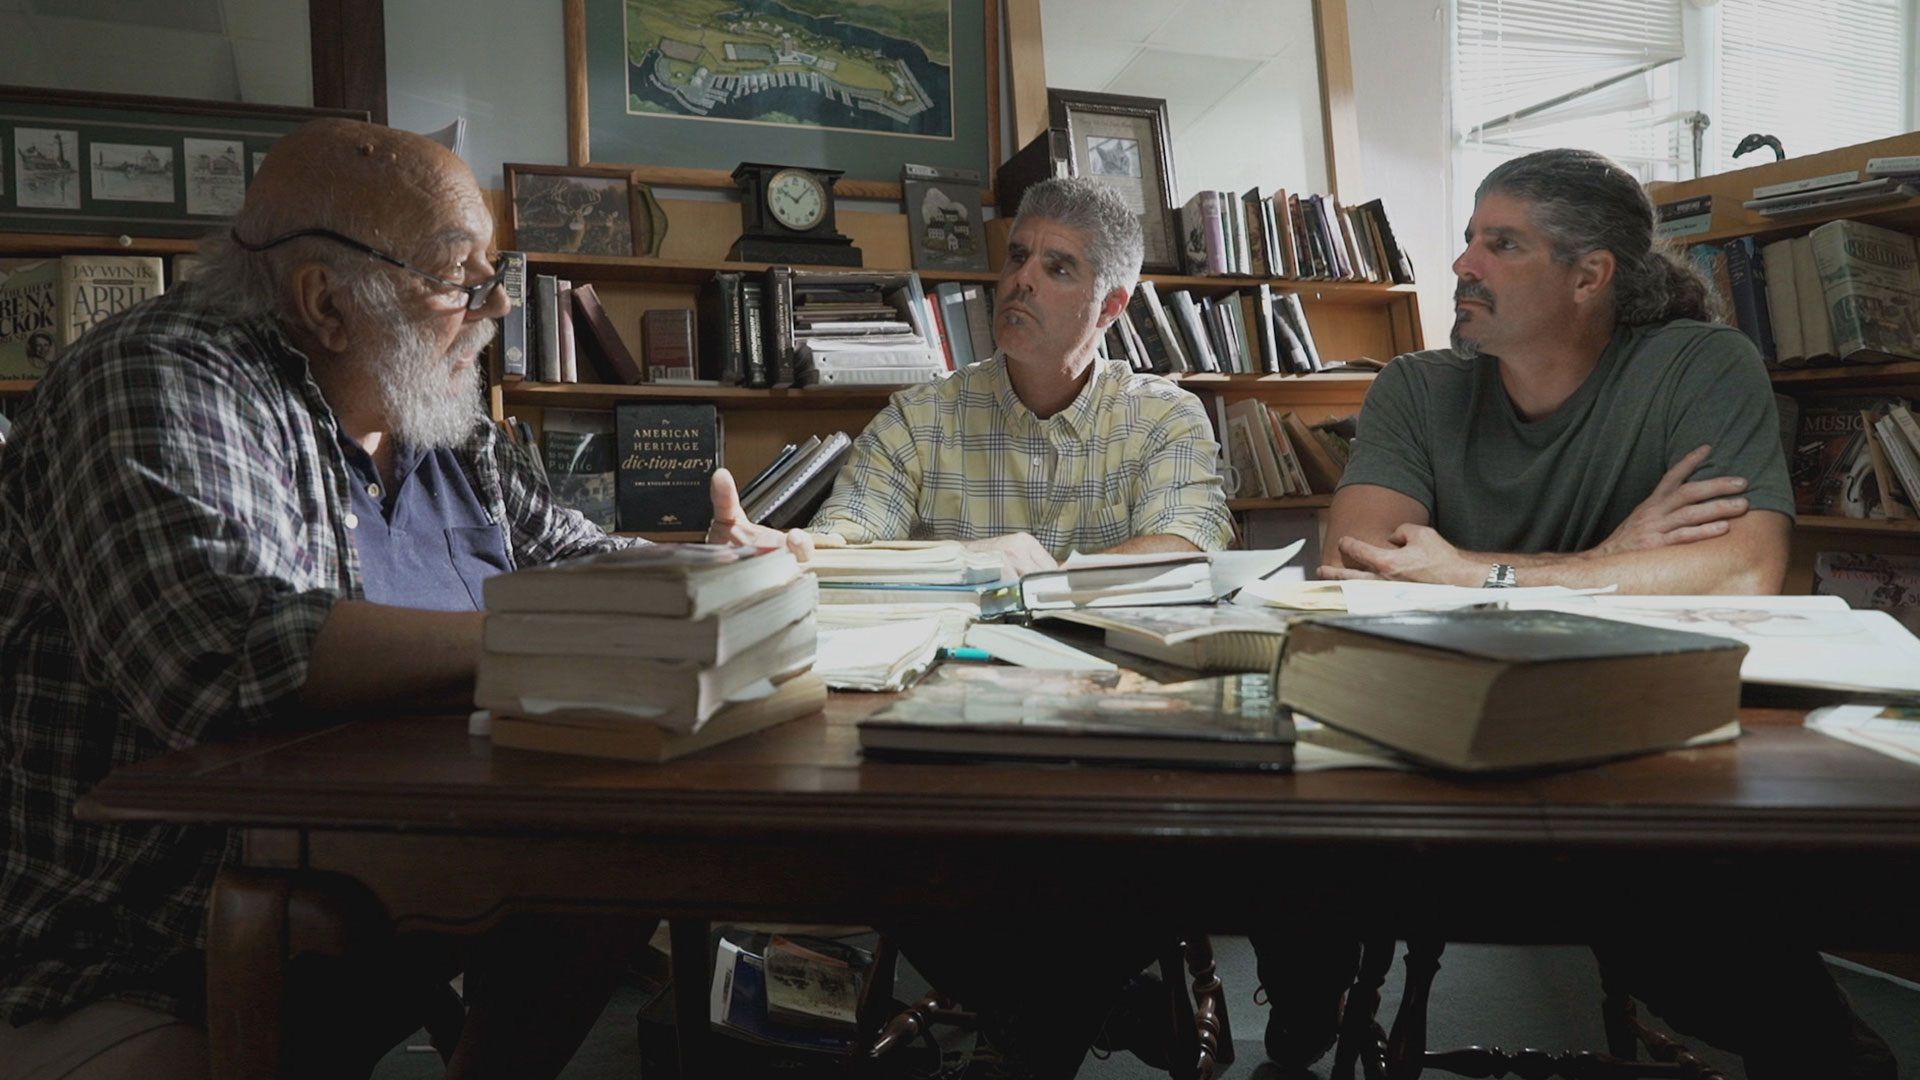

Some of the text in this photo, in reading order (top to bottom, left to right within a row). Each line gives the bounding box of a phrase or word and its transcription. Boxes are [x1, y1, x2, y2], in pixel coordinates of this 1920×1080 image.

[73, 265, 153, 278] JAY WINIK
[1804, 415, 1866, 431] MUSIC
[633, 429, 700, 438] AMERICAN
[633, 442, 700, 451] HERITAGE
